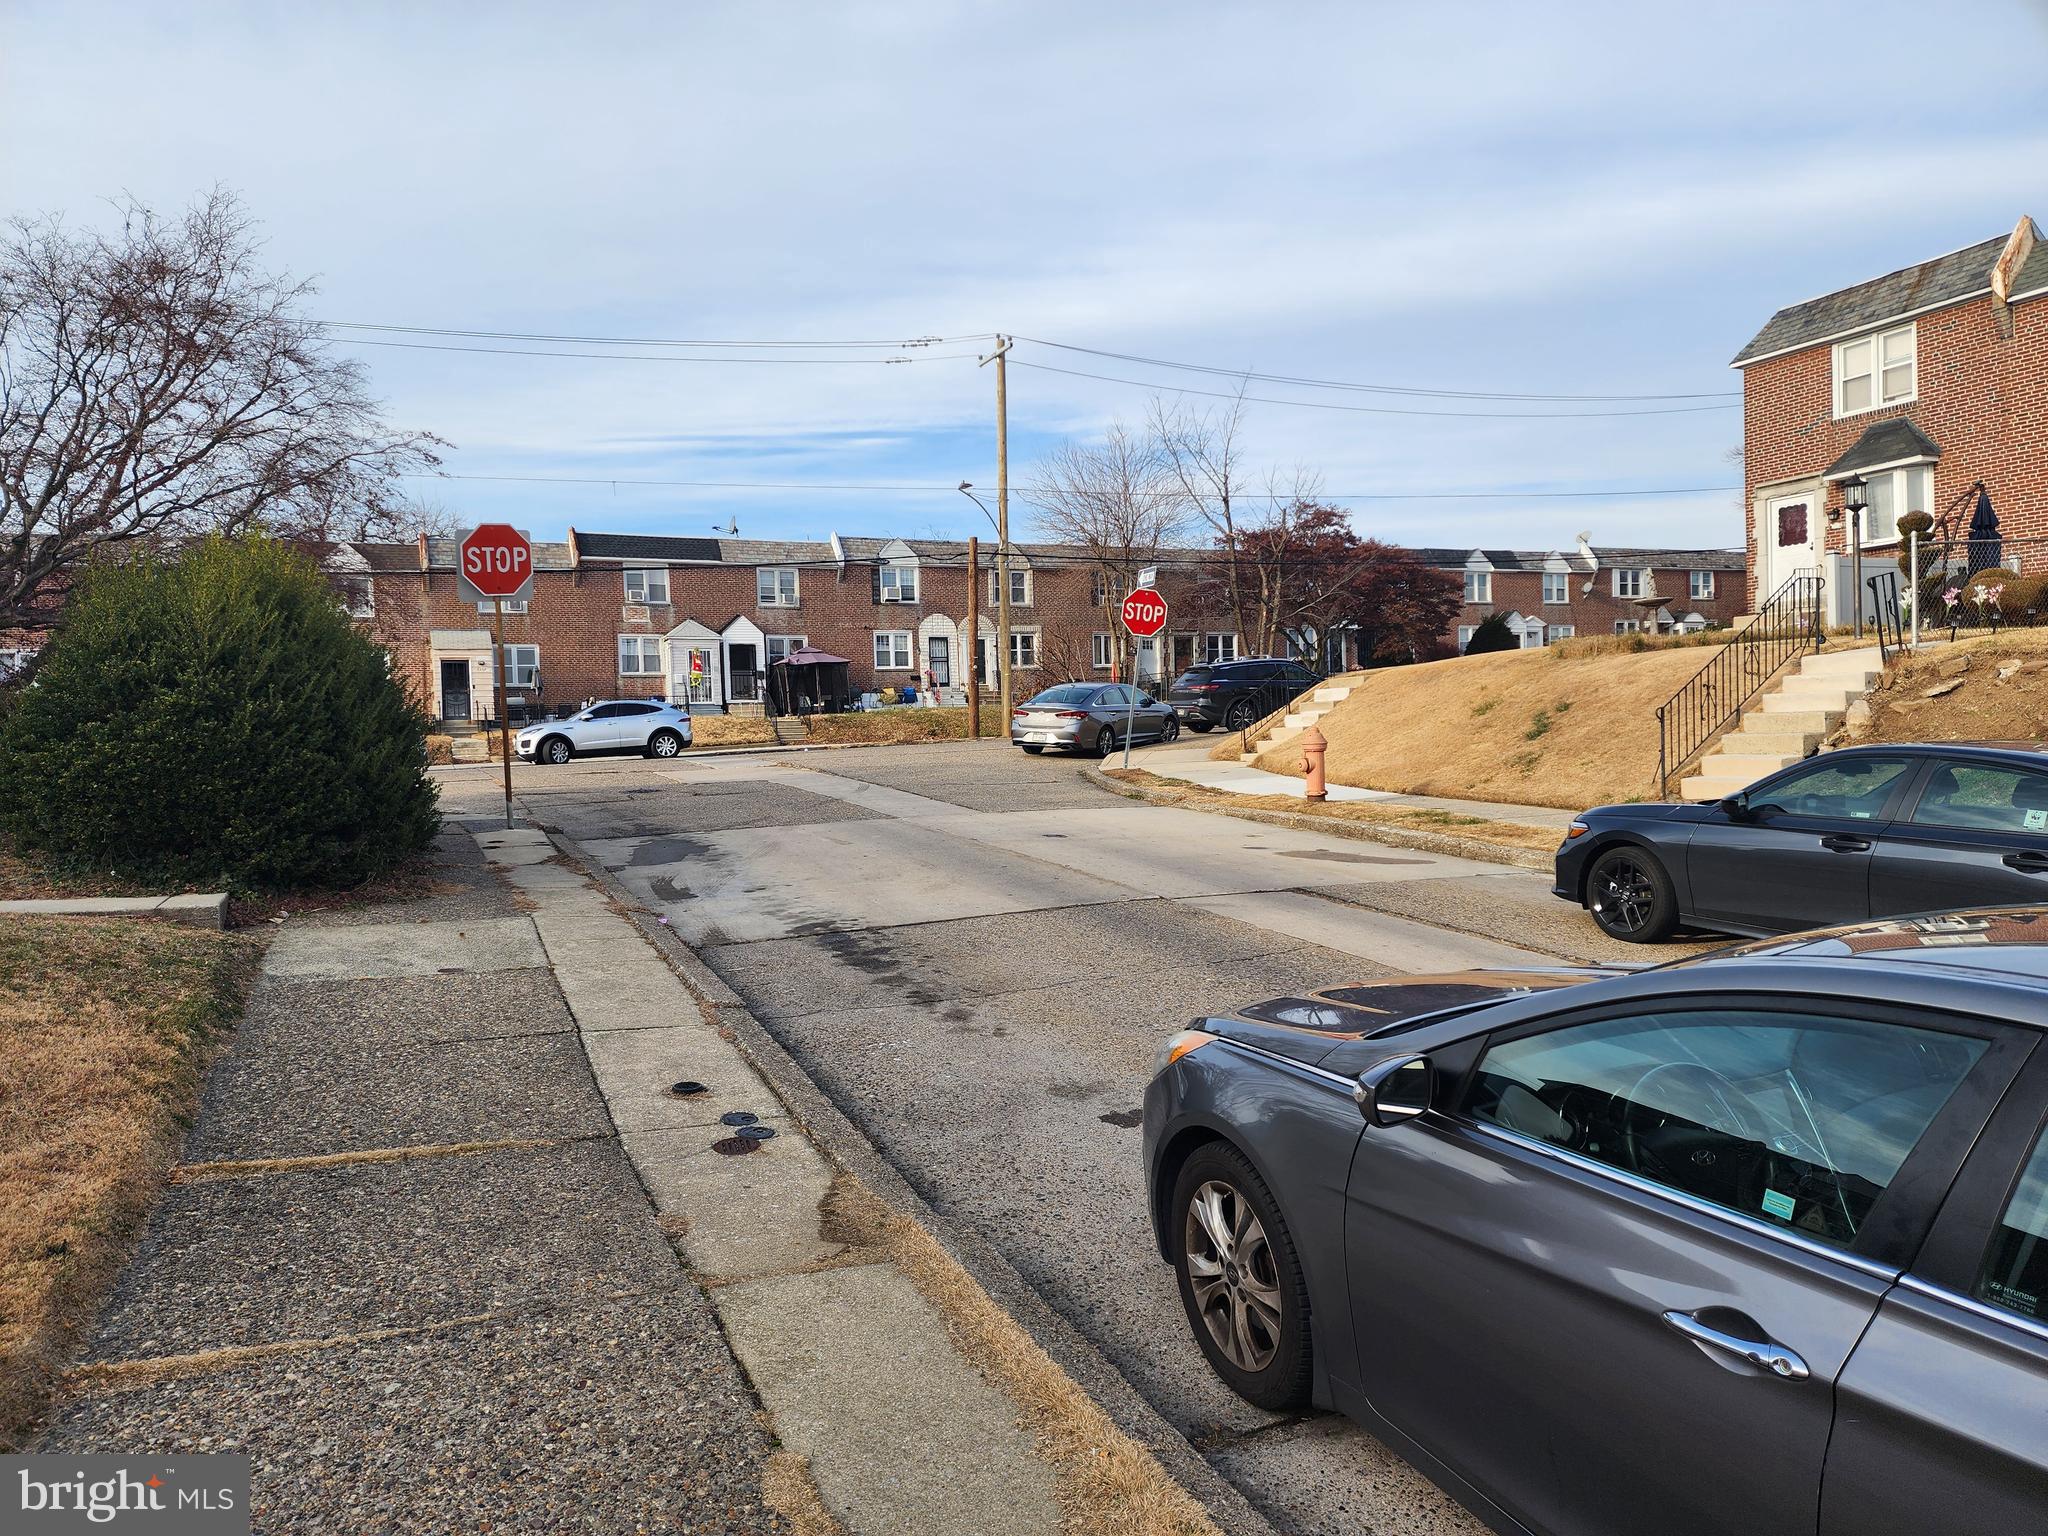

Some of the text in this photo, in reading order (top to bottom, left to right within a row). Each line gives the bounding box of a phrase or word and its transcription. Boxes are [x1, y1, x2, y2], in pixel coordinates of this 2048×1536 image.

[467, 546, 527, 573] STOP
[1125, 602, 1164, 623] STOP
[2003, 1286, 2037, 1303] HYUNDAI
